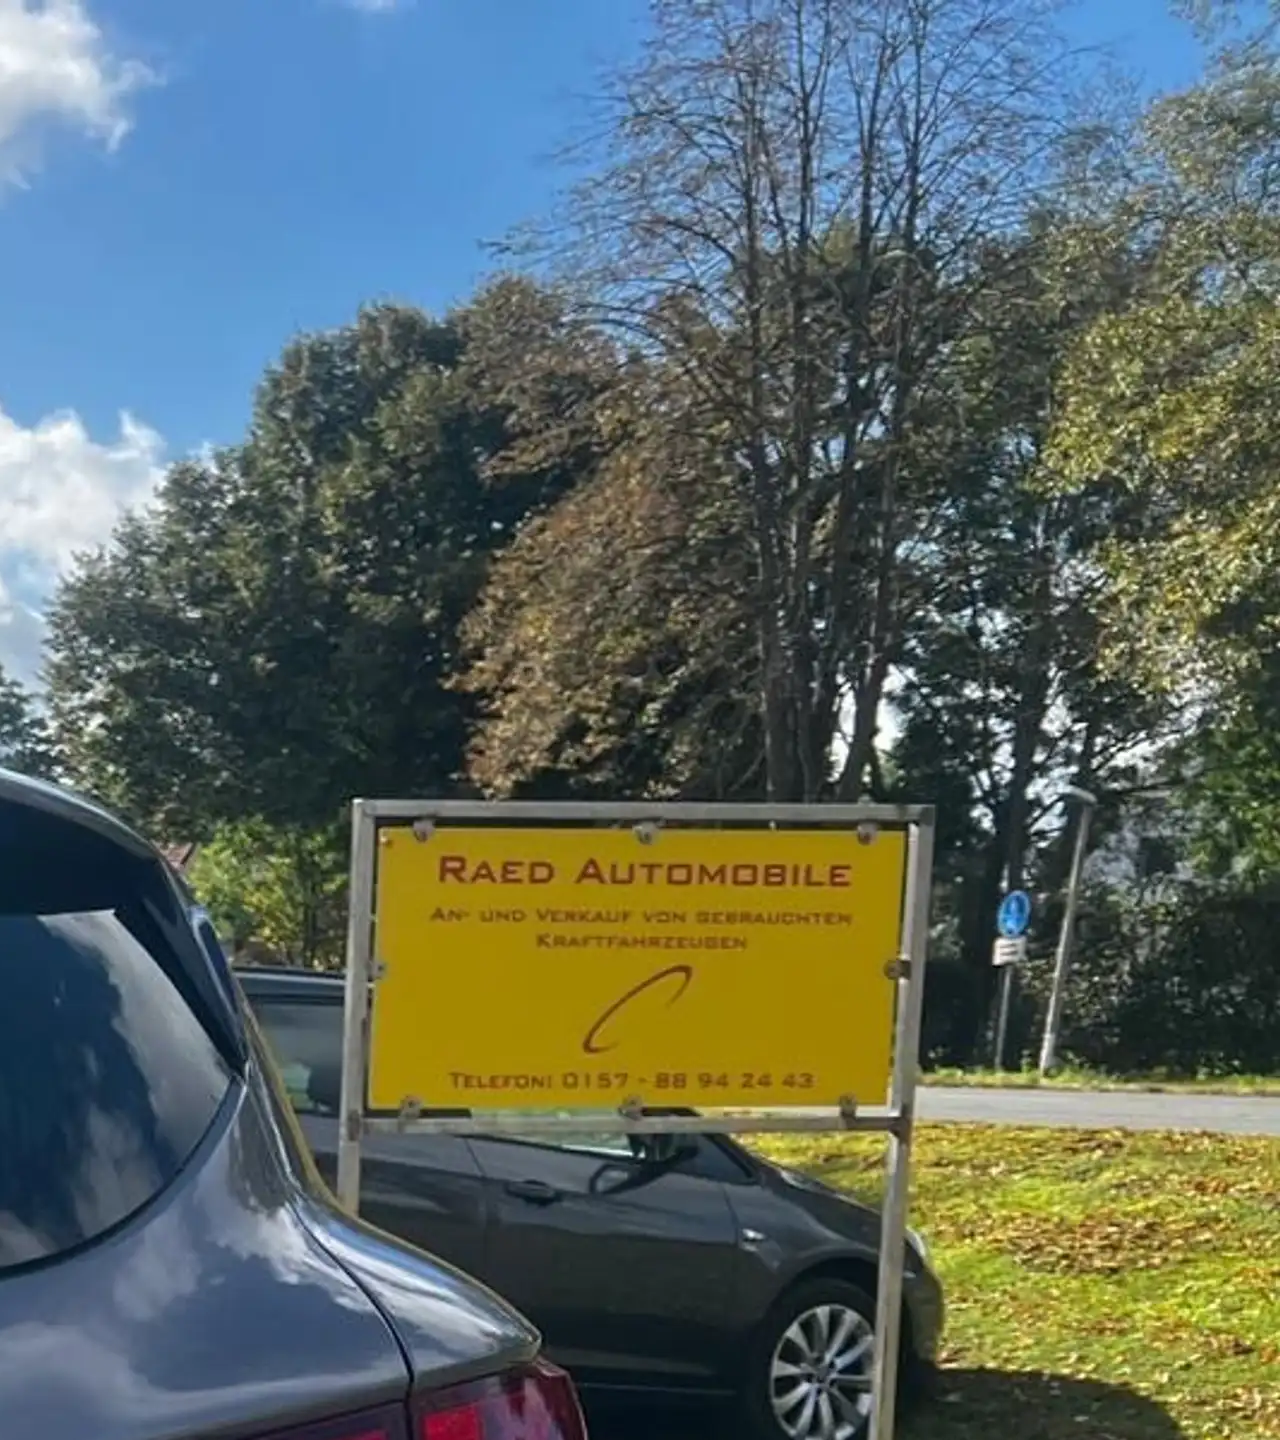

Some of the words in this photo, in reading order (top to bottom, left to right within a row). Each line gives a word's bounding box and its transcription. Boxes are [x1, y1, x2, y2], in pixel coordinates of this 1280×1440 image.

[439, 856, 554, 884] RAED
[574, 857, 852, 887] AUTOMOBILE
[479, 909, 526, 923] UND
[536, 909, 633, 923] VERKAUF
[643, 911, 687, 924] VON
[695, 911, 852, 926] GEBRAUCHTEN
[536, 934, 748, 950] KRAFTFAHRZEUGEN
[562, 1073, 628, 1089] 0157
[655, 1073, 687, 1088] 88
[697, 1073, 730, 1089] 94
[740, 1073, 773, 1088] 24
[781, 1073, 815, 1088] 43
